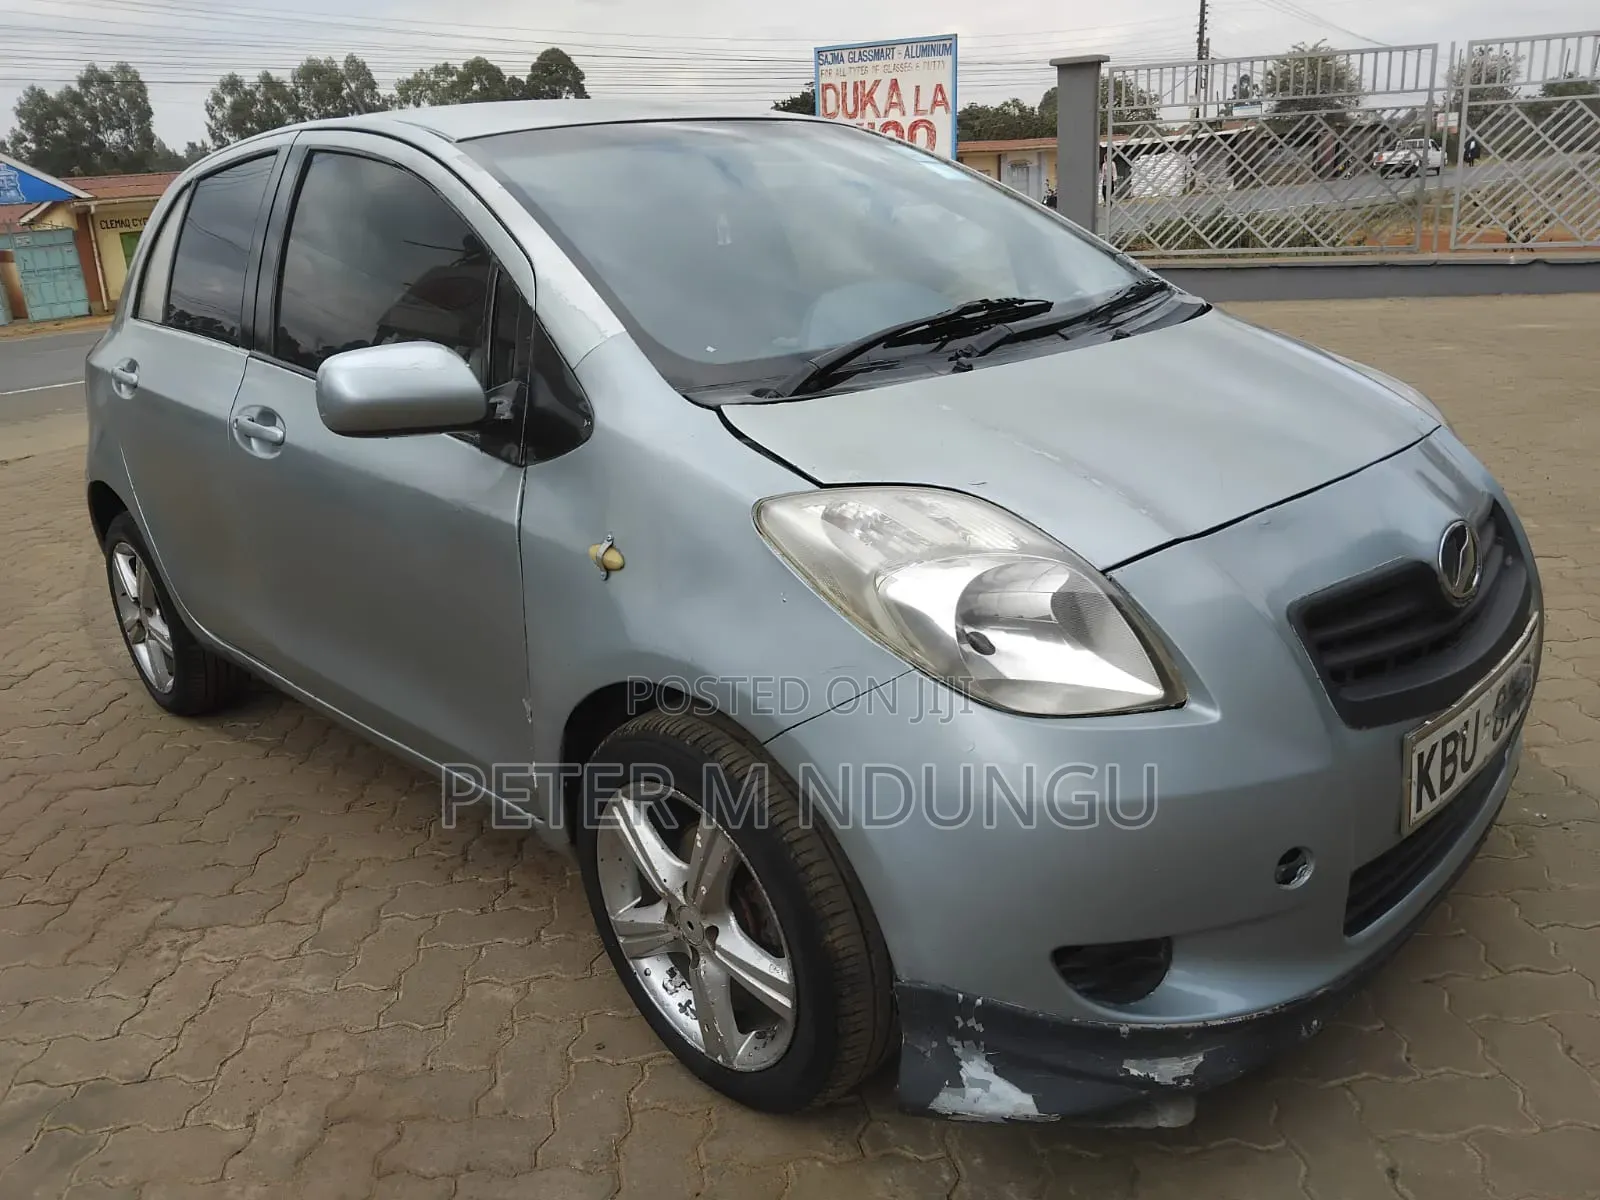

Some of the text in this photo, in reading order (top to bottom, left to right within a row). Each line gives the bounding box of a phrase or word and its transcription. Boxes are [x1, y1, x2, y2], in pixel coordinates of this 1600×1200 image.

[818, 51, 845, 66] SAJMA
[847, 47, 896, 63] GLASSMART
[903, 43, 952, 60] ALUMINIUM
[883, 62, 913, 74] GLASSES
[821, 78, 951, 119] DUKA LA
[1415, 709, 1480, 814] KBU
